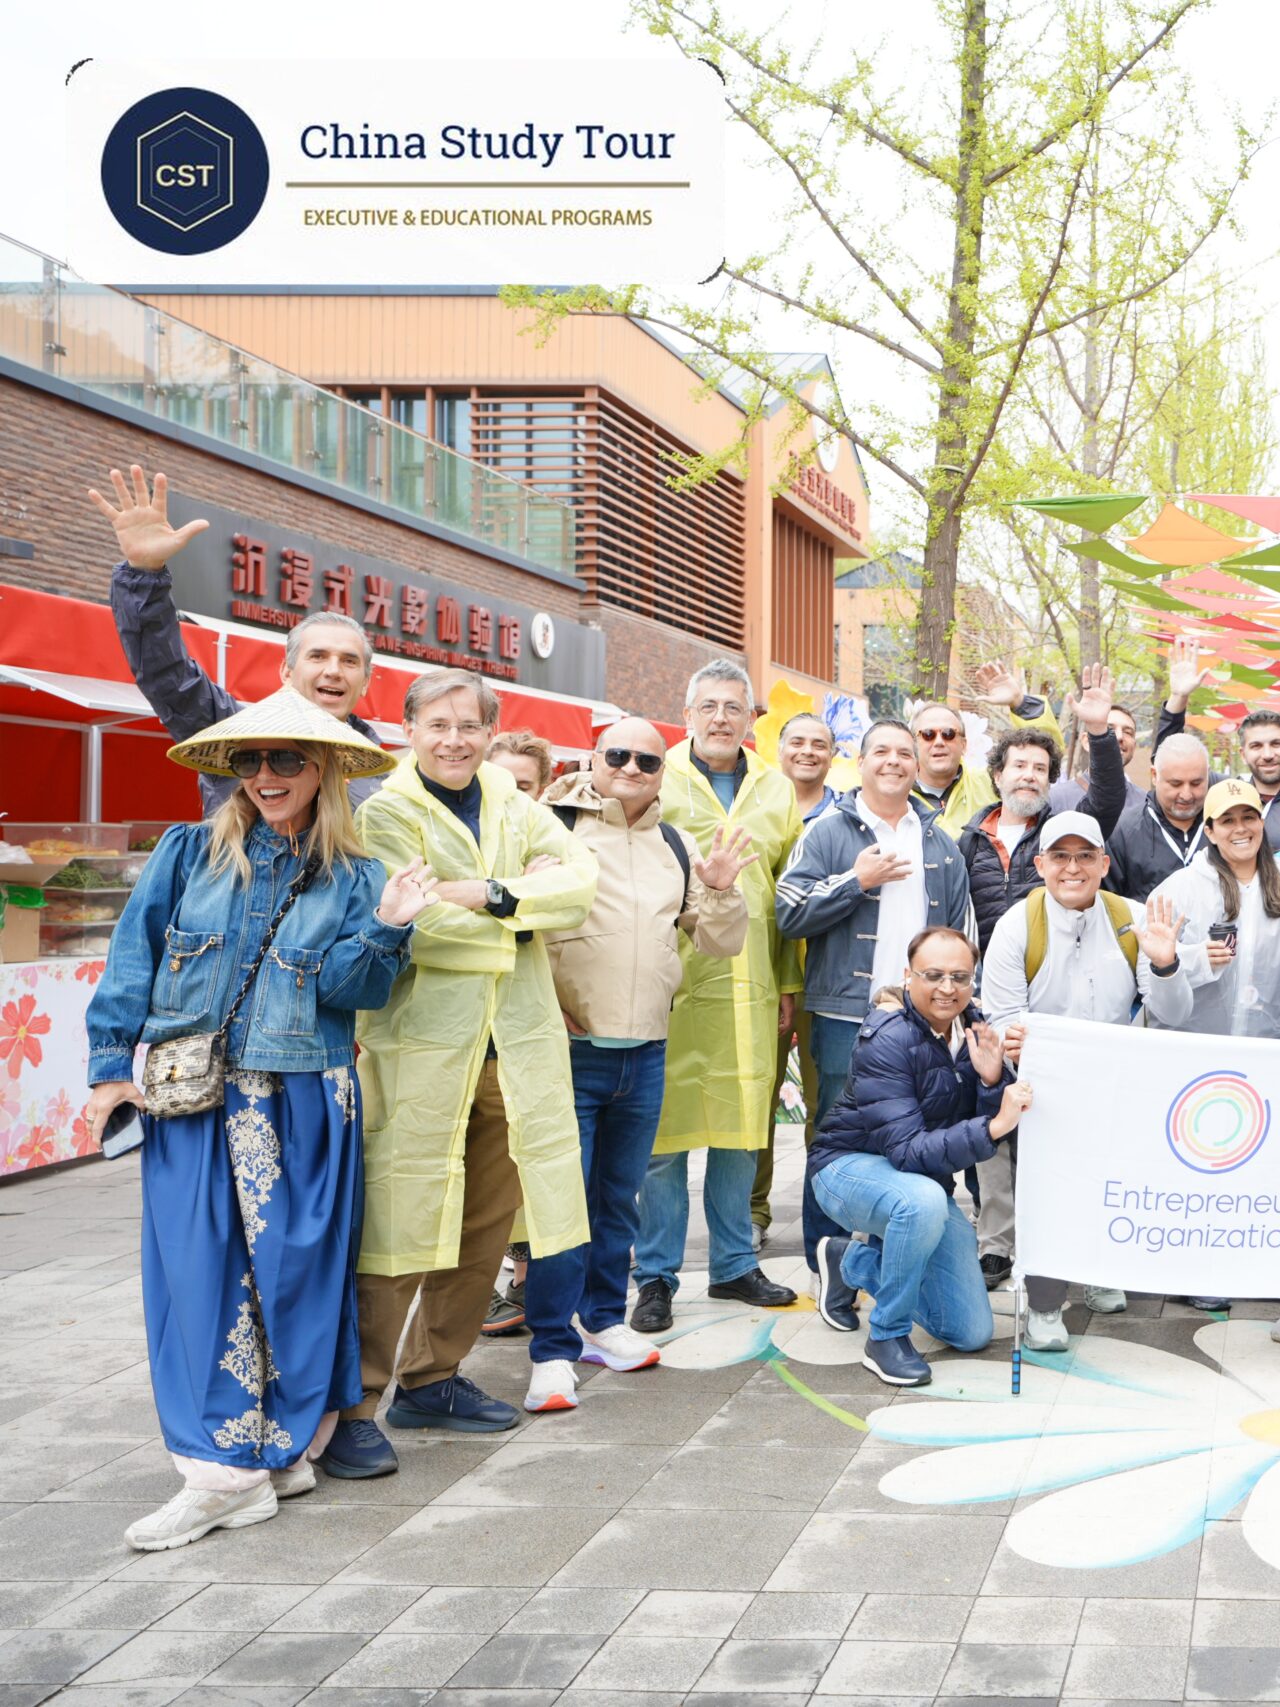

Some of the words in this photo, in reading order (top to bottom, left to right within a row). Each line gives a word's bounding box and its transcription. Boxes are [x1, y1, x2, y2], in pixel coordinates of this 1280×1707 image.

[231, 532, 522, 660] 沉浸式光影体验馆
